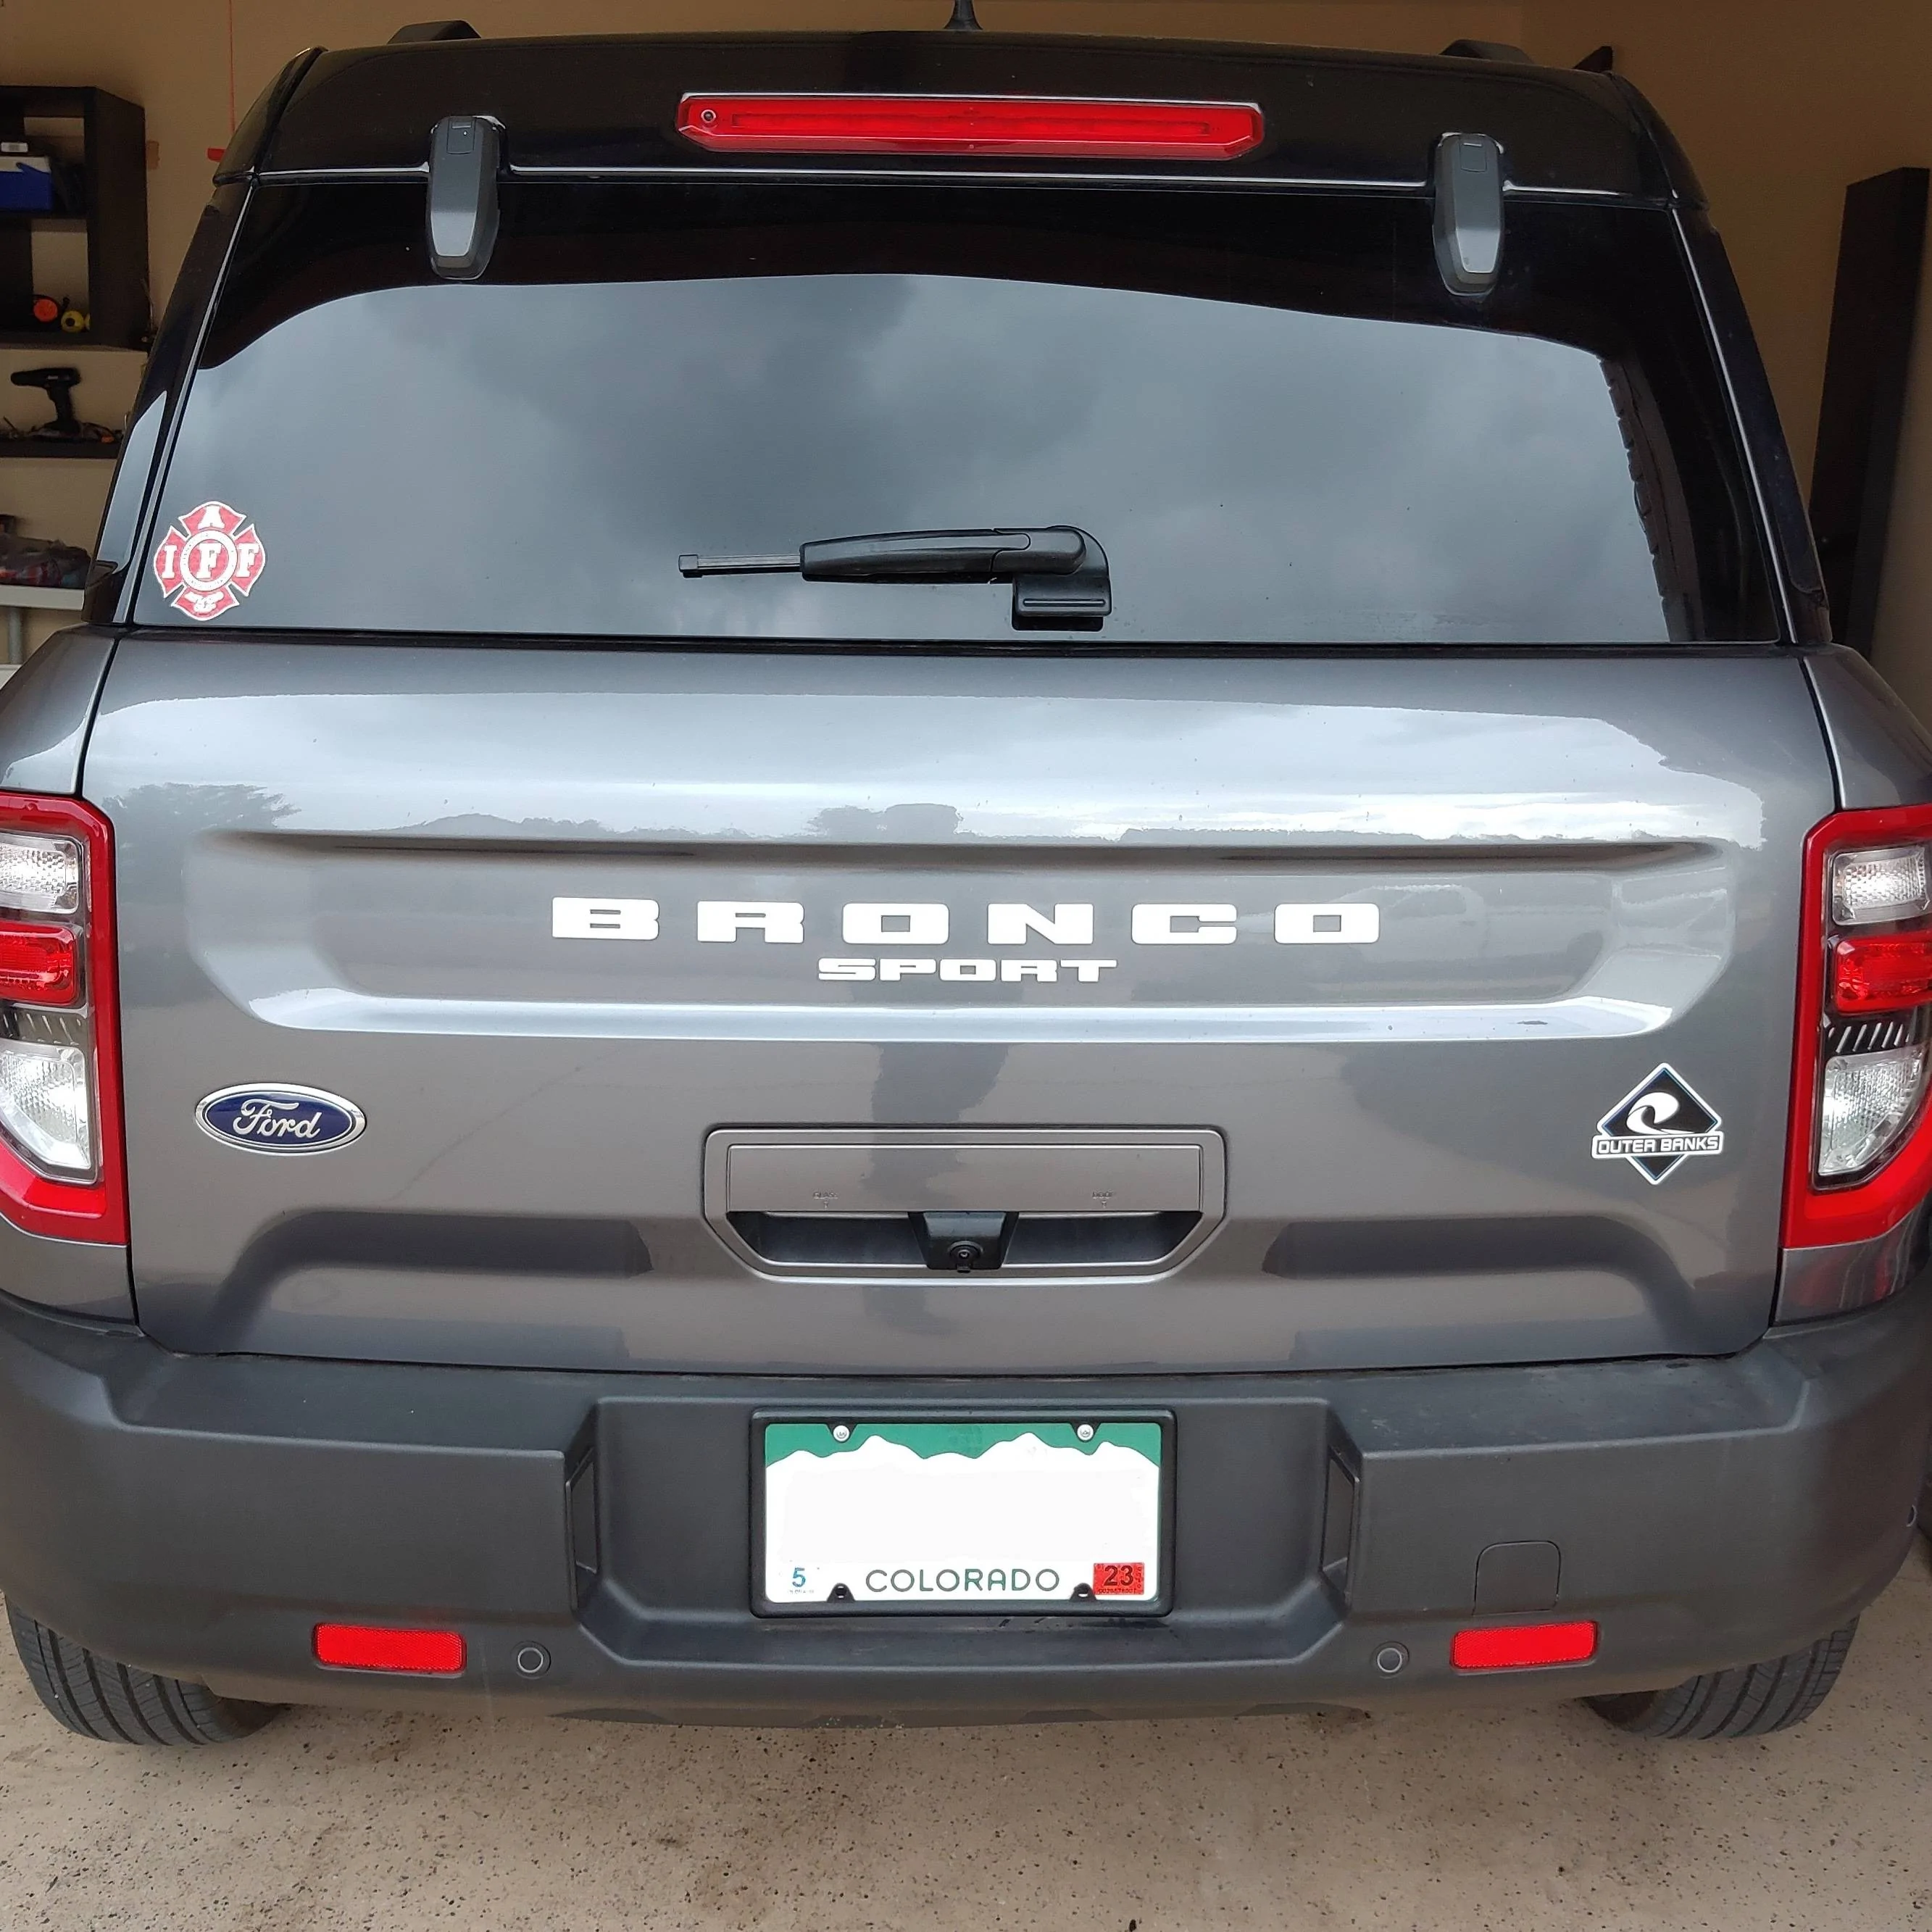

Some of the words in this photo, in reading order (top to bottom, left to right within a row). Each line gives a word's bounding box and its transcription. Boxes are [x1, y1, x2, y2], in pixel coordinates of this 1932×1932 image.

[551, 896, 1380, 945] BRONCO
[818, 957, 1118, 982] SPORT
[233, 1098, 322, 1138] Ford
[1597, 1138, 1656, 1154] OUTER
[1660, 1136, 1719, 1152] BANKS
[791, 1566, 806, 1588] 5
[865, 1568, 1060, 1593] COLORADO
[1103, 1565, 1134, 1586] 23
